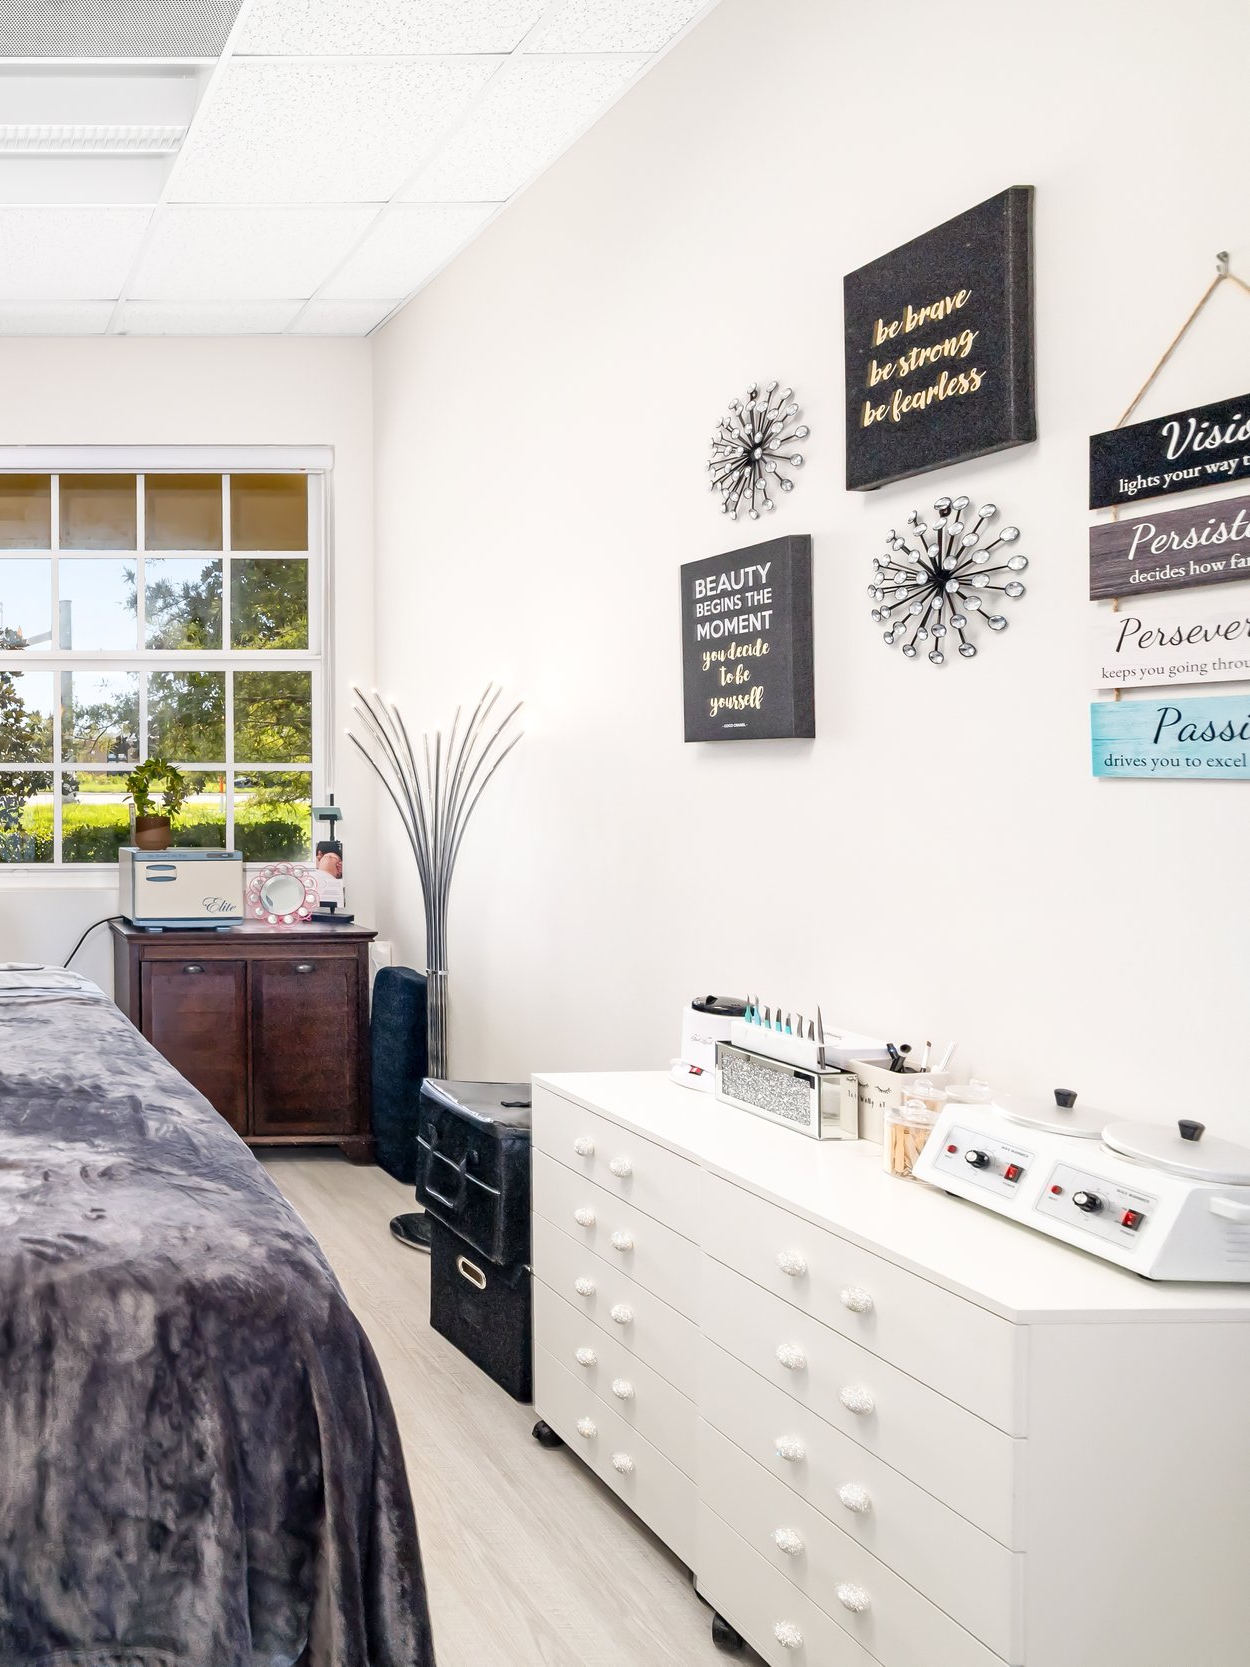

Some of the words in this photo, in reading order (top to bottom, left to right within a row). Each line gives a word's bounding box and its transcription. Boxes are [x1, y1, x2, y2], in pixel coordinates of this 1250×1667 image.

[874, 318, 903, 346] be
[905, 289, 972, 333] brave
[868, 359, 898, 387] be
[897, 329, 980, 377] strong
[862, 400, 890, 428] be
[891, 367, 987, 422] fearless
[1119, 474, 1160, 496] lights
[1163, 466, 1202, 489] your
[1204, 457, 1239, 475] way
[695, 562, 772, 599] BEAUTY
[1129, 565, 1186, 584] decides
[1189, 561, 1227, 576] how
[696, 594, 742, 618] BEGINS
[745, 588, 773, 607] THE
[697, 610, 773, 641] MOMENT
[702, 647, 727, 672] you
[727, 638, 770, 661] decide
[719, 665, 735, 687] to
[735, 664, 751, 685] be
[1101, 667, 1137, 682] keeps
[1139, 665, 1165, 681] you
[1168, 661, 1208, 679] going
[709, 685, 764, 718] yourself
[1104, 753, 1147, 768] drives
[1150, 756, 1180, 772] you
[1185, 756, 1201, 767] to
[1206, 753, 1247, 768] excel
[202, 896, 237, 914] Elite
